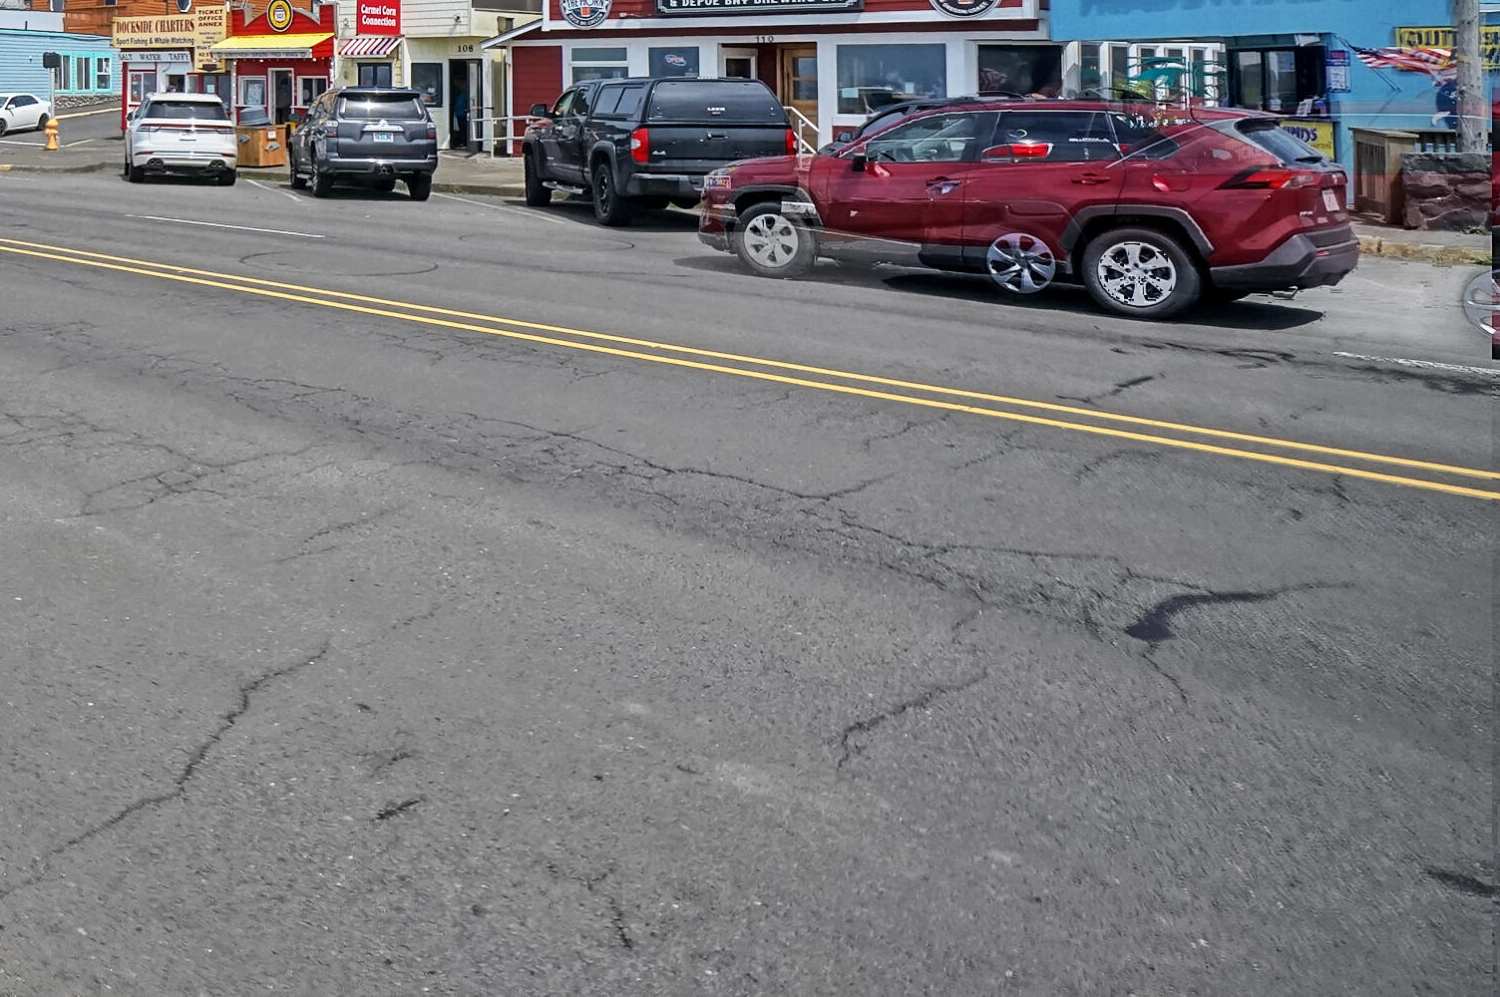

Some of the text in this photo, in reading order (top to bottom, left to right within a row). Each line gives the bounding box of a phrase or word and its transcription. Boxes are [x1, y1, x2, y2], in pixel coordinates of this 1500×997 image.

[361, 4, 396, 16] Carmel Corn
[116, 19, 195, 33] DOCKSIDE CHARTERS
[362, 15, 396, 26] Connection
[130, 37, 148, 46] Fishing
[171, 37, 195, 45] Watching
[457, 45, 474, 53] 108
